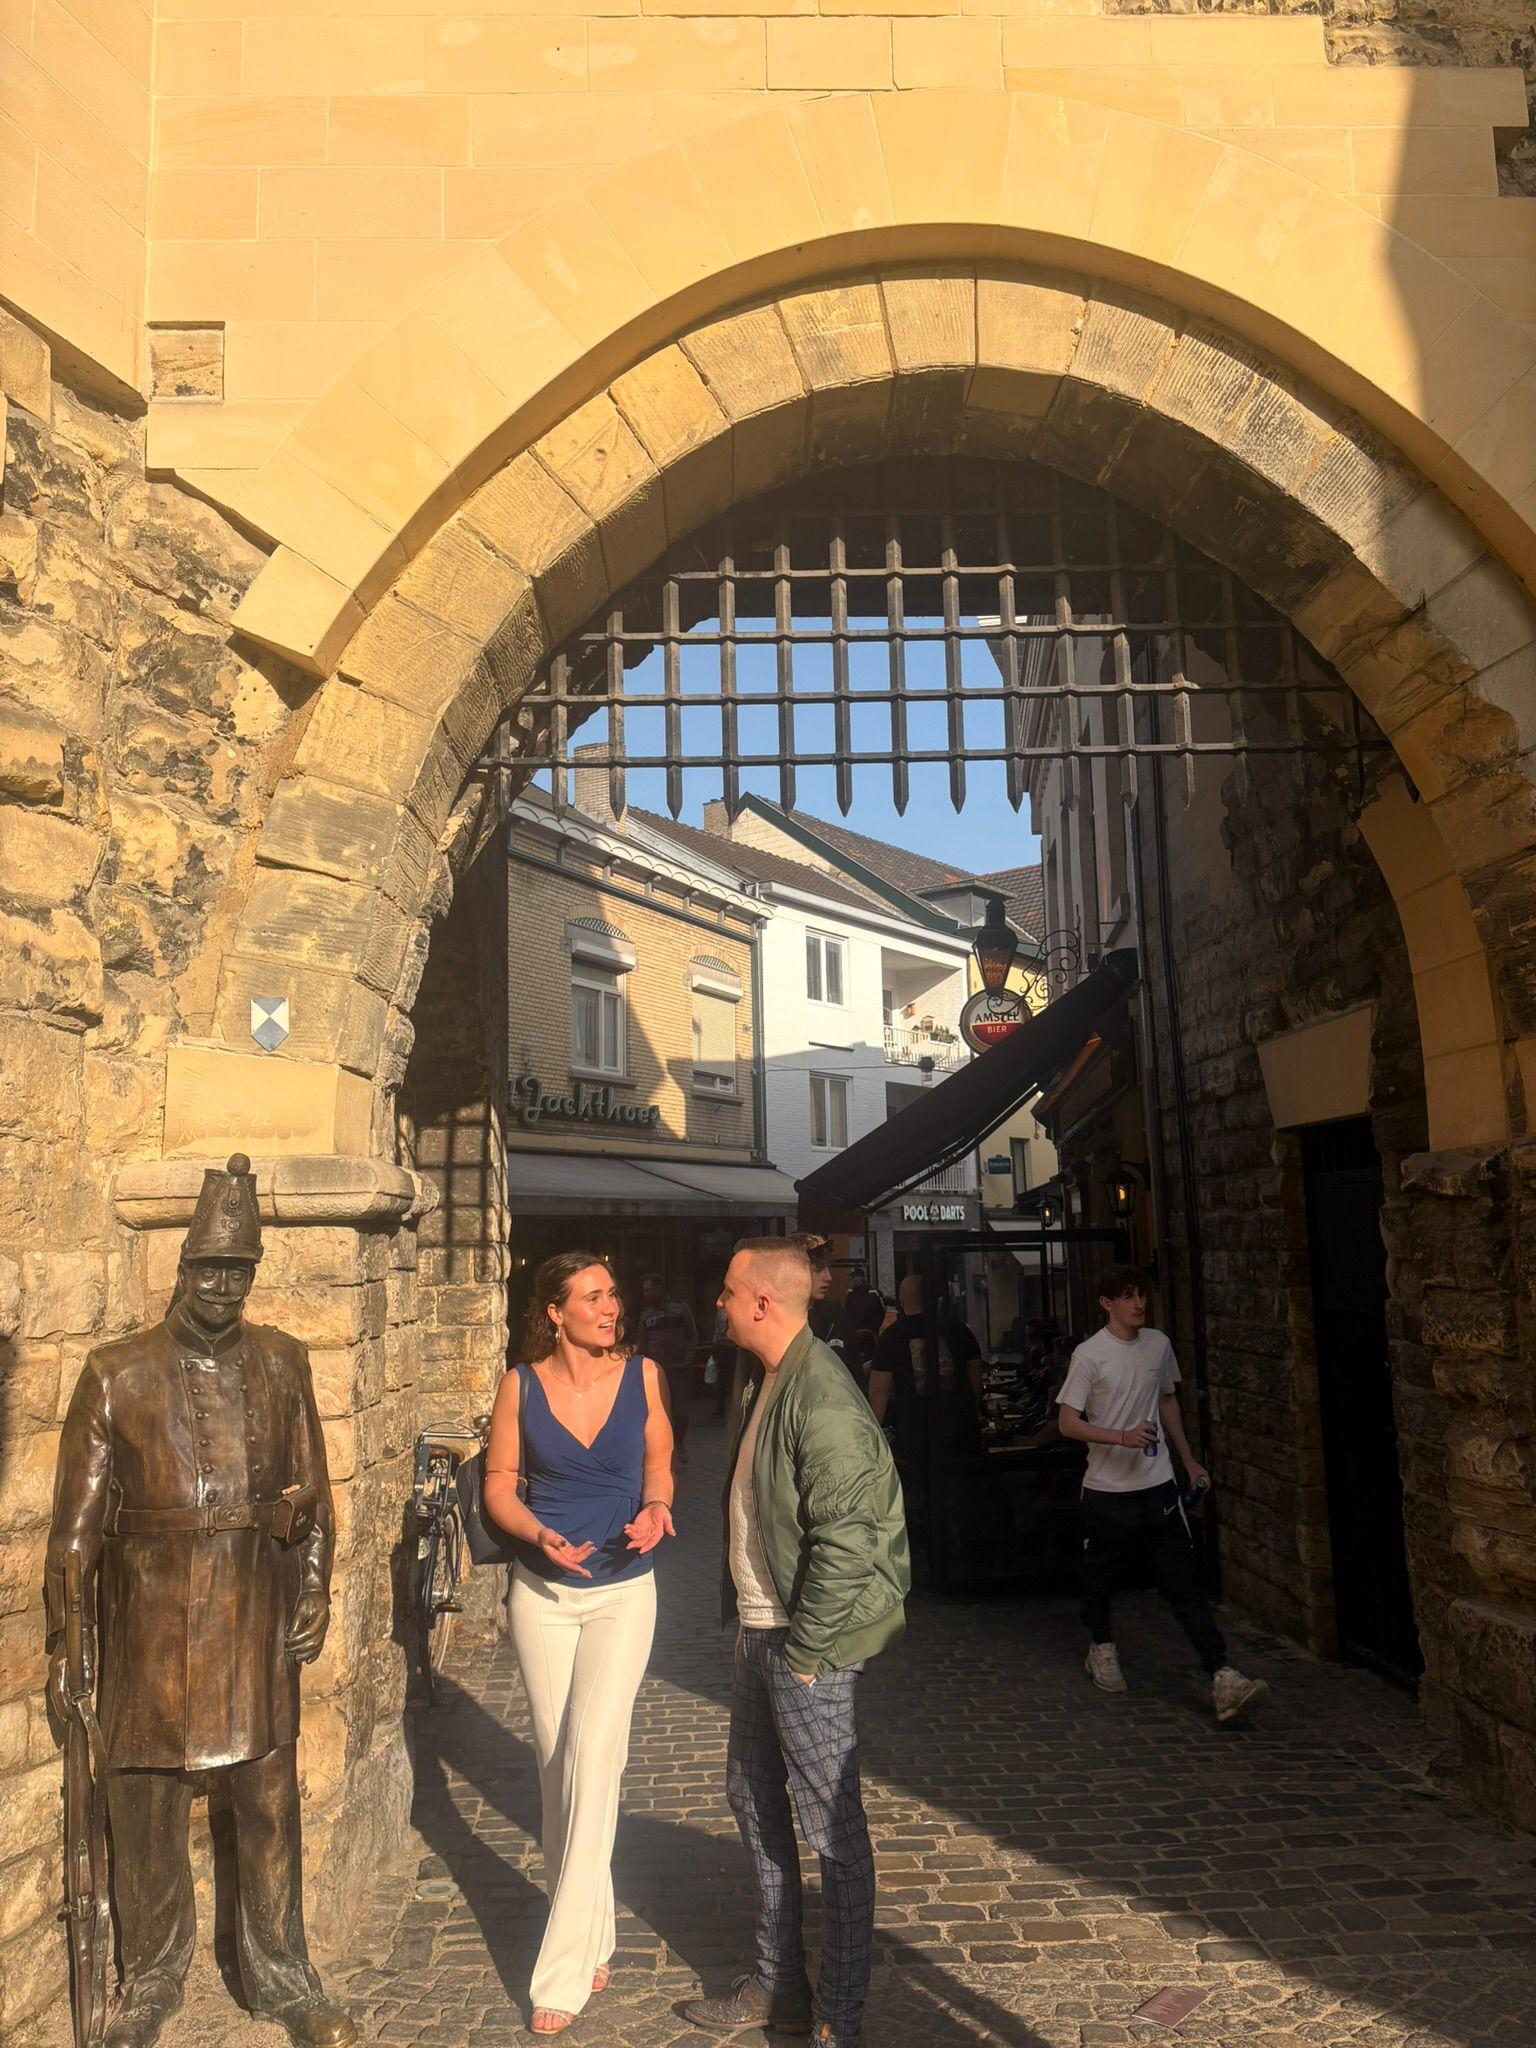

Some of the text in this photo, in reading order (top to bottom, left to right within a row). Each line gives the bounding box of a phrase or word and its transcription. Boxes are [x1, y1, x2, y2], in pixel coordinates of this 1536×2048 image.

[987, 1025, 1007, 1034] BIER
[903, 1204, 966, 1220] POOL DARTS
